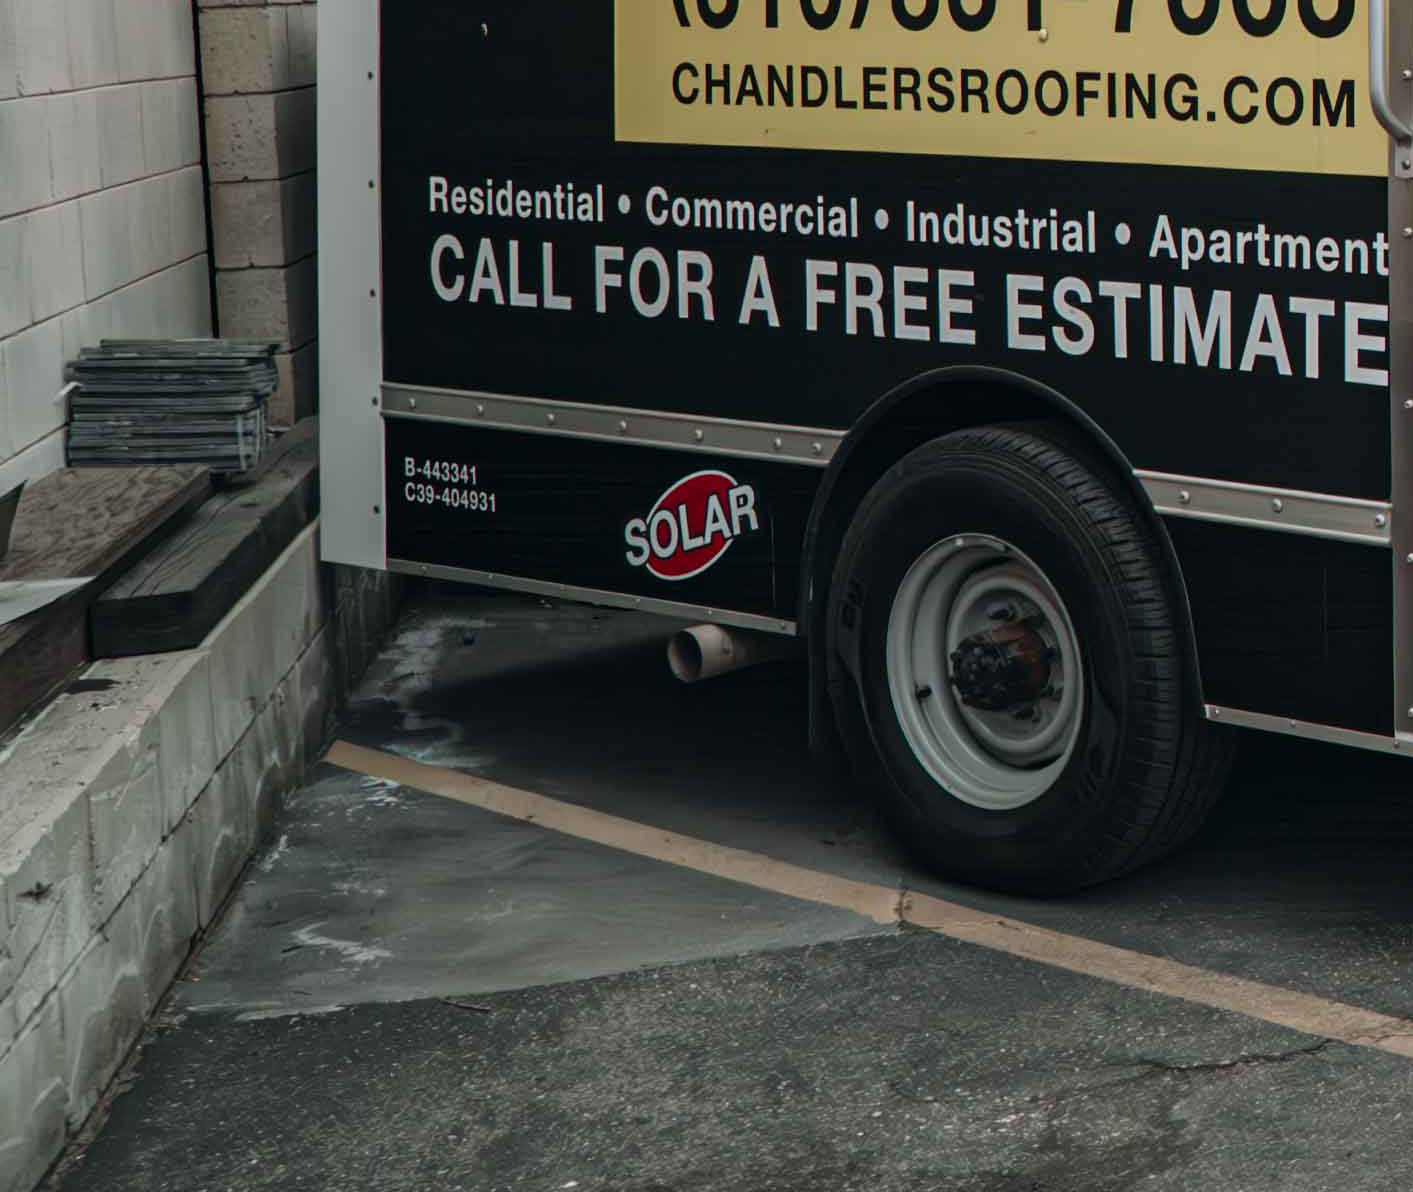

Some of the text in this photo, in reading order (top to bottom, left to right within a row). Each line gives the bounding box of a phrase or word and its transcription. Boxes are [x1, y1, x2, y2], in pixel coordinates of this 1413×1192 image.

[671, 61, 1356, 128] CHANDLERSROOFING.COM
[429, 176, 1389, 276] Residential Commercial Industrial Apartment
[430, 234, 1389, 387] CALL FOR A FREE ESTIMATE
[404, 456, 477, 486] B-443341
[404, 481, 496, 513] C39-404931
[623, 483, 760, 569] SOLAR
